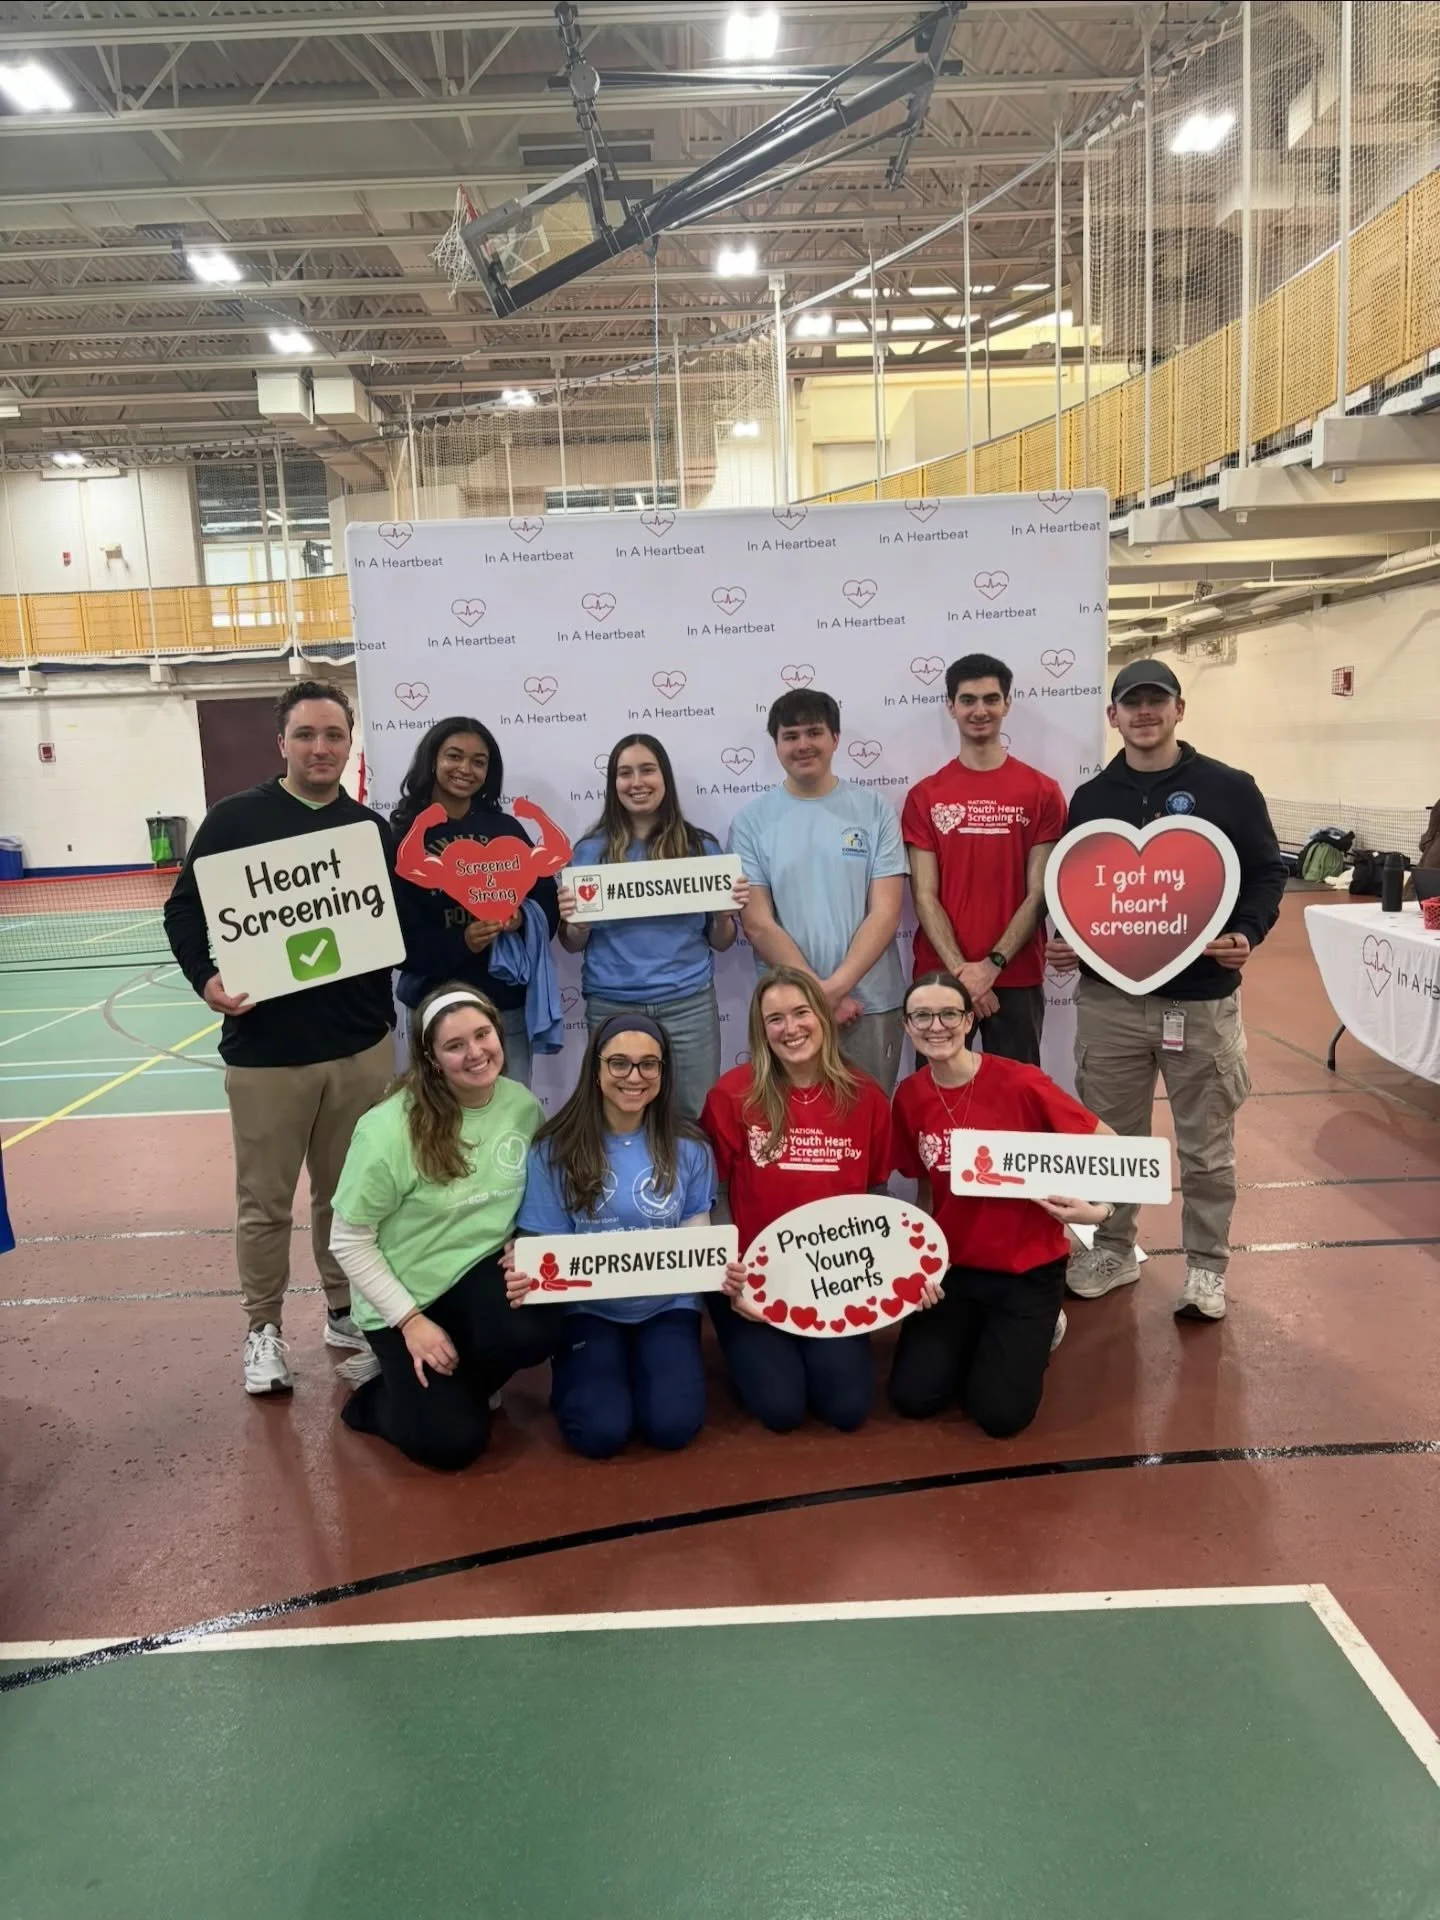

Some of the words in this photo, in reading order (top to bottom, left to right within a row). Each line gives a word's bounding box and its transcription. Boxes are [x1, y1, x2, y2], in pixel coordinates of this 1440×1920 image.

[1012, 526, 1022, 535] In
[1026, 524, 1036, 534] A
[1040, 521, 1100, 533] Heartbeat
[880, 534, 889, 543] In
[894, 532, 903, 543] A
[907, 529, 968, 542] Heartbeat
[616, 548, 626, 557] In
[631, 546, 640, 556] A
[644, 544, 704, 556] Heartbeat
[748, 541, 758, 551] In
[762, 540, 771, 551] A
[776, 537, 836, 550] Heartbeat
[354, 557, 365, 568] In
[369, 558, 378, 568] A
[382, 556, 443, 568] Heartbeat
[485, 554, 496, 563] In
[500, 552, 509, 562] A
[513, 550, 574, 561] Heartbeat
[948, 612, 958, 621] In
[962, 610, 972, 620] A
[976, 607, 1036, 619] Heartbeat
[1080, 603, 1089, 613] In
[1094, 602, 1103, 612] A
[817, 619, 827, 628] In
[832, 618, 841, 628] A
[845, 615, 905, 627] Heartbeat
[558, 632, 568, 641] In
[572, 631, 581, 640] A
[585, 629, 645, 640] Heartbeat
[688, 626, 697, 636] In
[702, 625, 711, 634] A
[715, 622, 775, 634] Heartbeat
[428, 638, 438, 647] In
[442, 636, 452, 647] A
[455, 634, 515, 646] Heartbeat
[1014, 688, 1024, 698] In
[1028, 688, 1037, 698] A
[1042, 685, 1102, 696] Heartbeat
[885, 696, 895, 706] In
[899, 695, 908, 704] A
[628, 709, 638, 719] In
[642, 708, 652, 718] A
[655, 706, 715, 718] Heartbeat
[756, 704, 766, 712] In
[500, 715, 511, 724] In
[515, 714, 524, 724] A
[528, 712, 586, 723] Heartbeat
[372, 721, 382, 731] In
[386, 720, 396, 730] A
[1080, 764, 1090, 775] In
[571, 792, 580, 800] In
[585, 790, 594, 800] A
[697, 784, 707, 795] In
[711, 784, 720, 795] A
[968, 805, 995, 814] Youth
[998, 805, 1024, 814] Heart
[967, 813, 1014, 824] Screening
[1016, 814, 1031, 827] Day
[244, 848, 341, 898] Heart
[456, 856, 520, 876] Screened
[486, 874, 496, 887] &
[1094, 865, 1107, 887] I
[1113, 865, 1147, 893] got
[1153, 868, 1186, 892] my
[606, 874, 732, 900] #AEDSSAVELIVES
[468, 887, 517, 904] Strong
[1111, 892, 1168, 914] heart
[218, 884, 385, 942] Screening
[1090, 914, 1188, 936] screened!
[1397, 967, 1408, 989] In
[1411, 973, 1420, 993] A
[789, 1127, 824, 1136] NATIONAL
[789, 1135, 821, 1146] Youth
[824, 1136, 853, 1147] Heart
[789, 1145, 842, 1160] Screening
[844, 1149, 862, 1160] Day
[1003, 1152, 1160, 1179] #CPRSAVESLIVES
[777, 1214, 891, 1253] Protecting
[569, 1247, 728, 1277] #CPRSAVESLIVES
[805, 1246, 876, 1274] Young
[810, 1268, 884, 1300] Hearts
